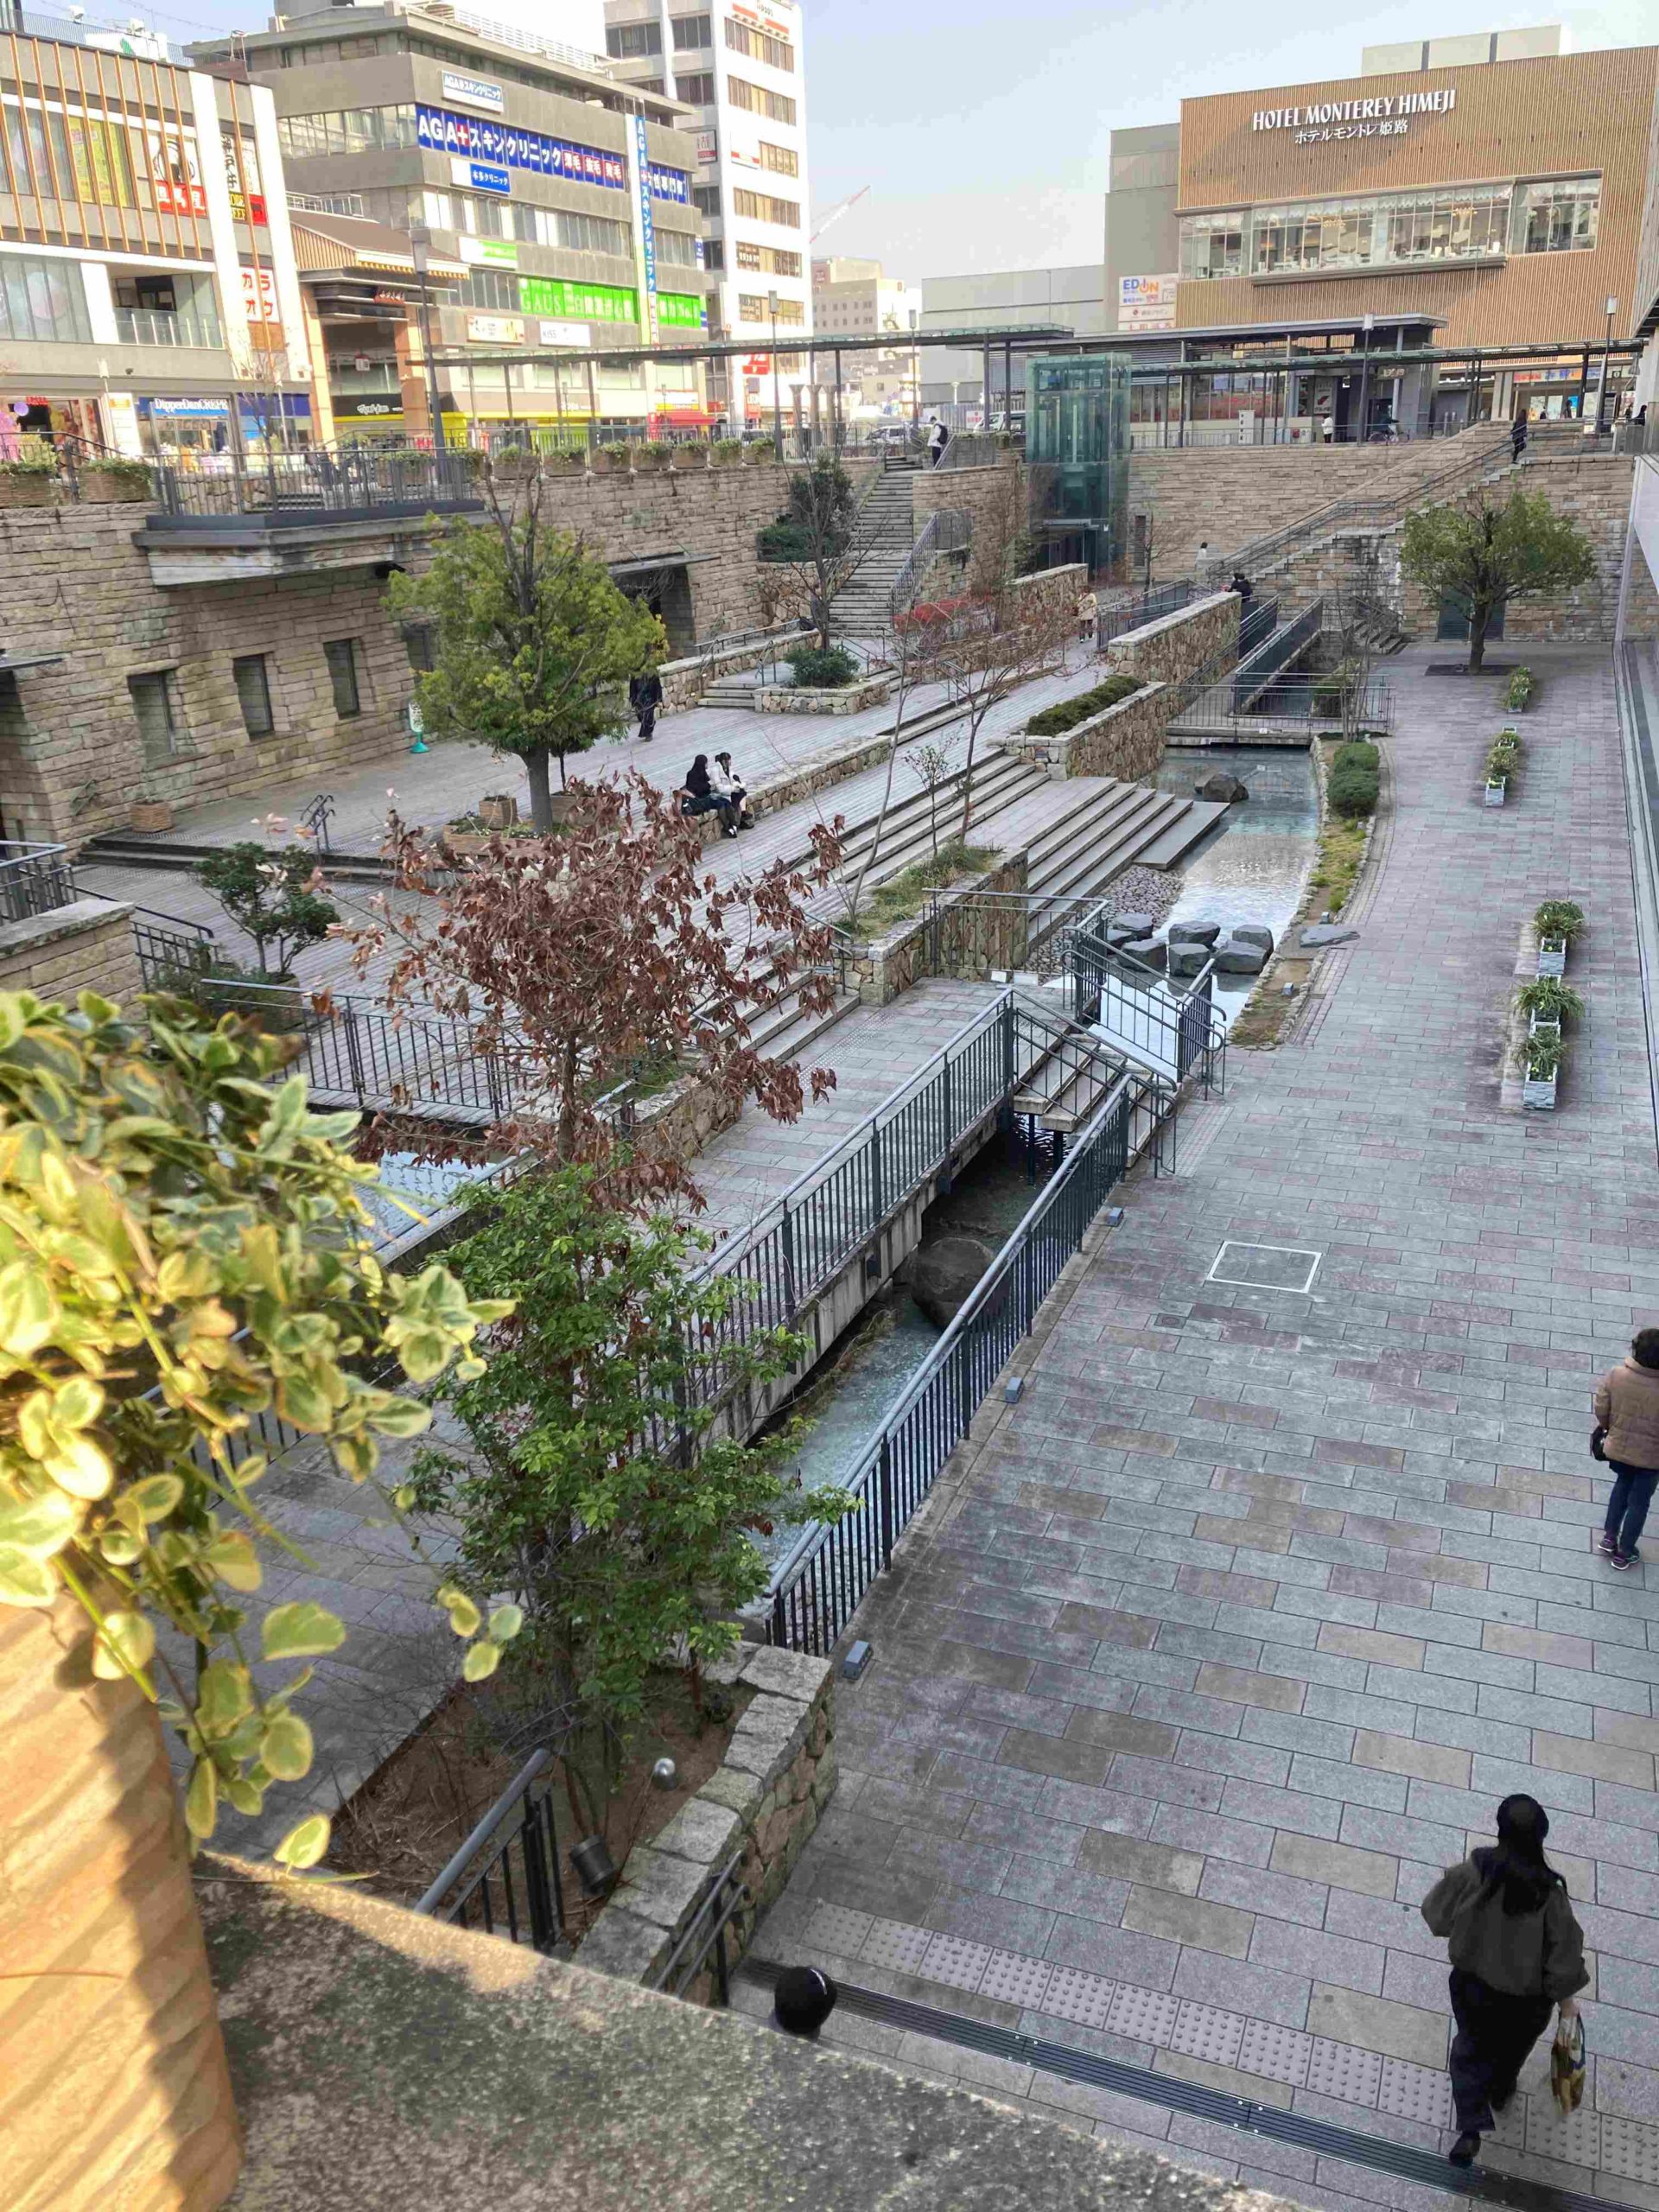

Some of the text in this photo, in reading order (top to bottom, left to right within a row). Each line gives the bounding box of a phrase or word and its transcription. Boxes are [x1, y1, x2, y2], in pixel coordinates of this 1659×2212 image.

[1253, 89, 1456, 130] HOTEL MONTEREY HIMEJI
[1123, 277, 1160, 294] EDION
